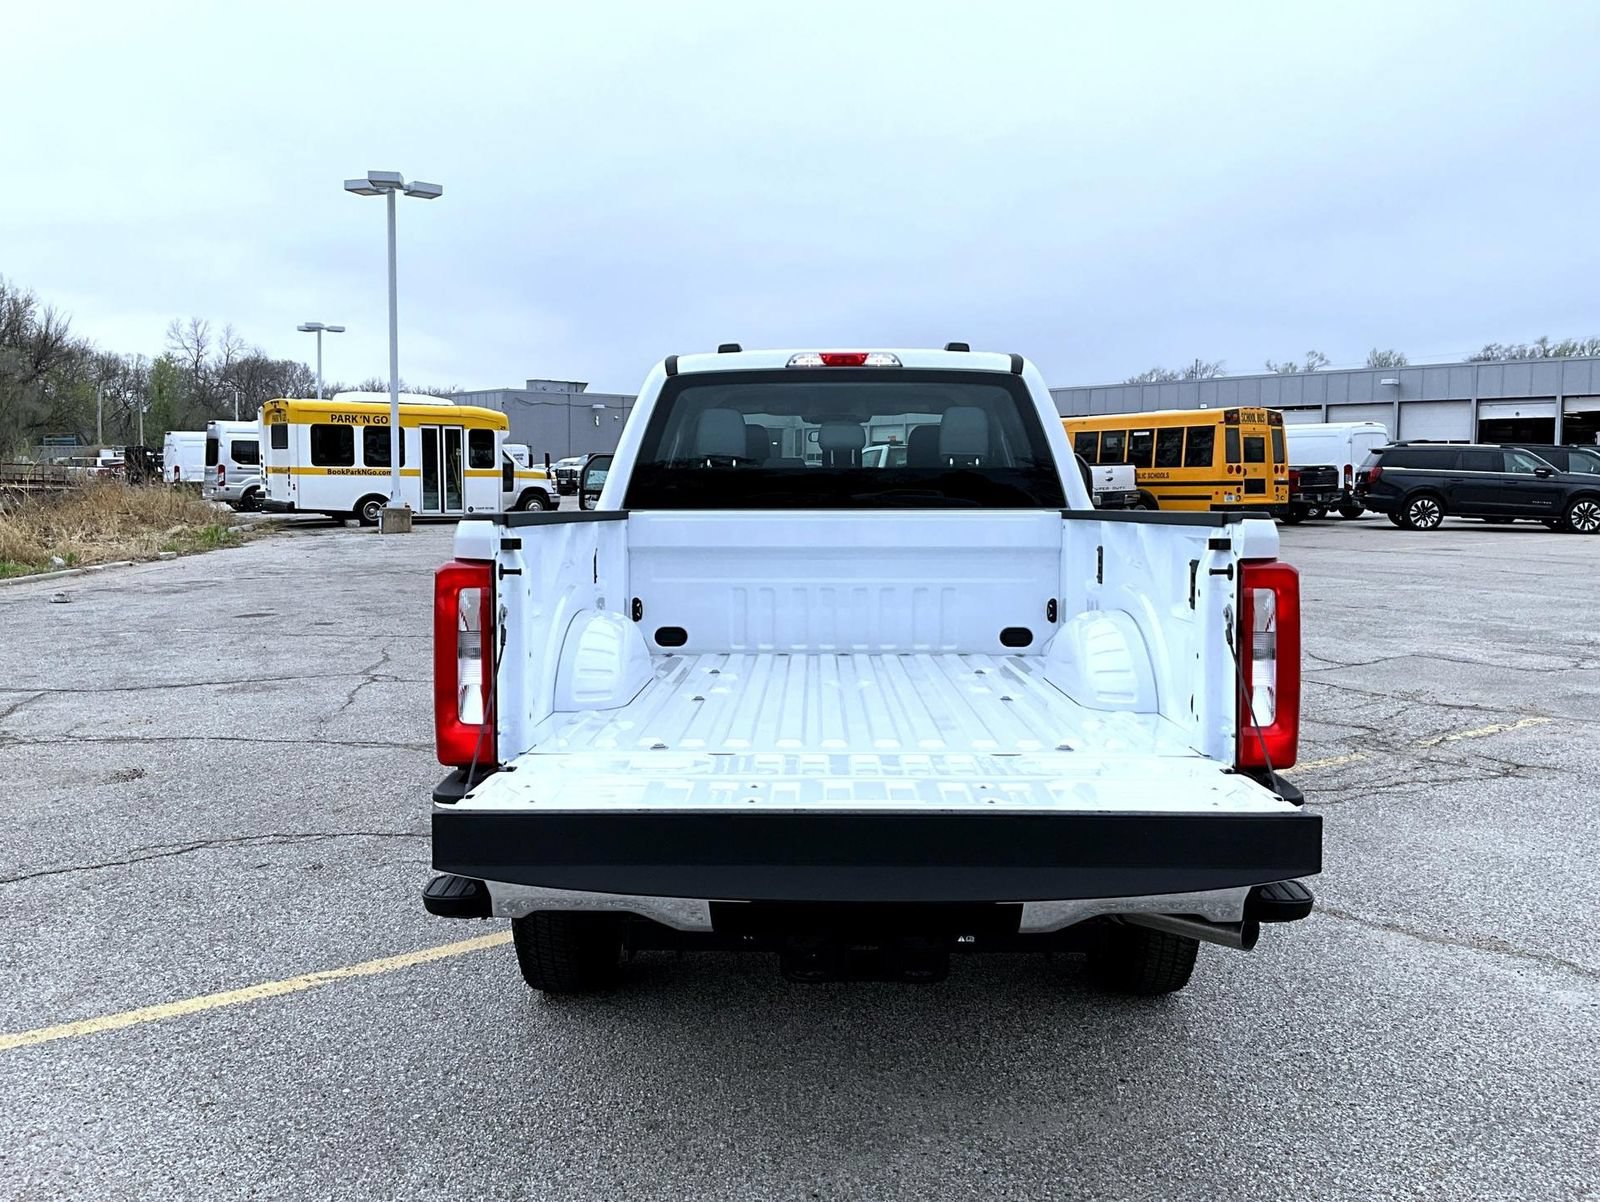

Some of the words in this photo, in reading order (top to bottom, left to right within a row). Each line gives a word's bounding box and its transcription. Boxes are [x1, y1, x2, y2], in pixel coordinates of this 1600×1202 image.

[331, 414, 358, 423] PARK
[373, 415, 388, 424] GO
[1241, 412, 1256, 423] SCHOOL
[1257, 413, 1265, 423] BUS
[1148, 471, 1169, 479] SCHOOLS
